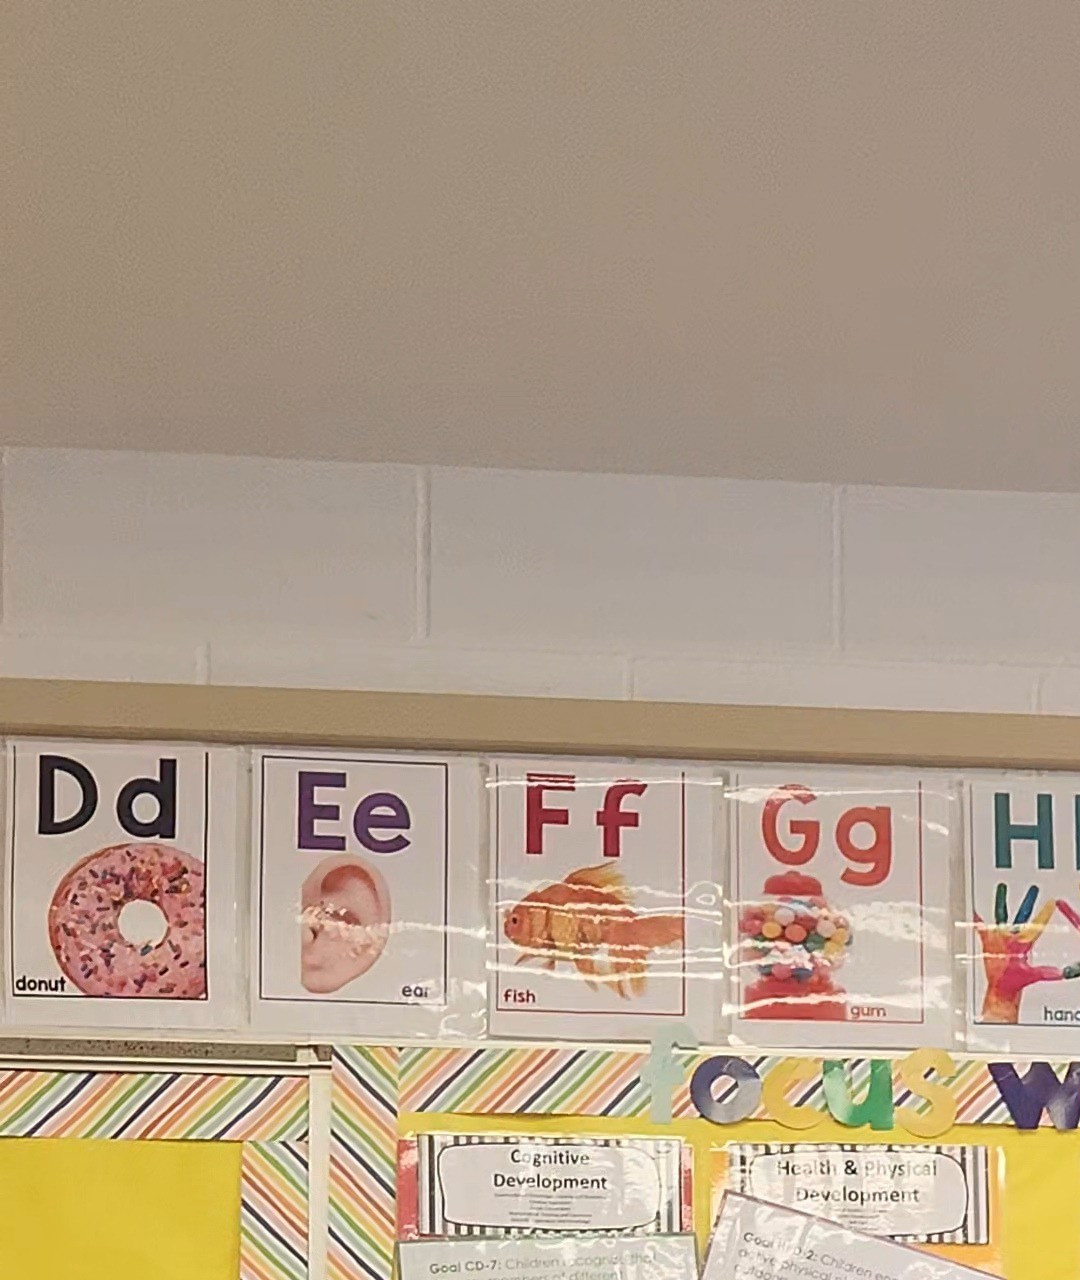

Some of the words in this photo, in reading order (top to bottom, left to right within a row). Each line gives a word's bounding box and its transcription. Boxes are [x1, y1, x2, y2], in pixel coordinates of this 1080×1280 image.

[37, 755, 178, 839] Dd
[297, 770, 411, 853] Ee
[525, 773, 647, 857] Ff
[761, 784, 893, 886] Gg
[15, 976, 66, 994] donut
[401, 985, 430, 998] ear
[503, 987, 536, 1005] fish
[850, 1004, 887, 1020] gum
[510, 1149, 590, 1167] Cognitive
[776, 1160, 837, 1176] Health
[844, 1161, 857, 1175] &
[865, 1160, 937, 1179] Physical
[493, 1173, 608, 1191] Development
[796, 1186, 920, 1206] Development
[429, 1261, 461, 1275] Goal
